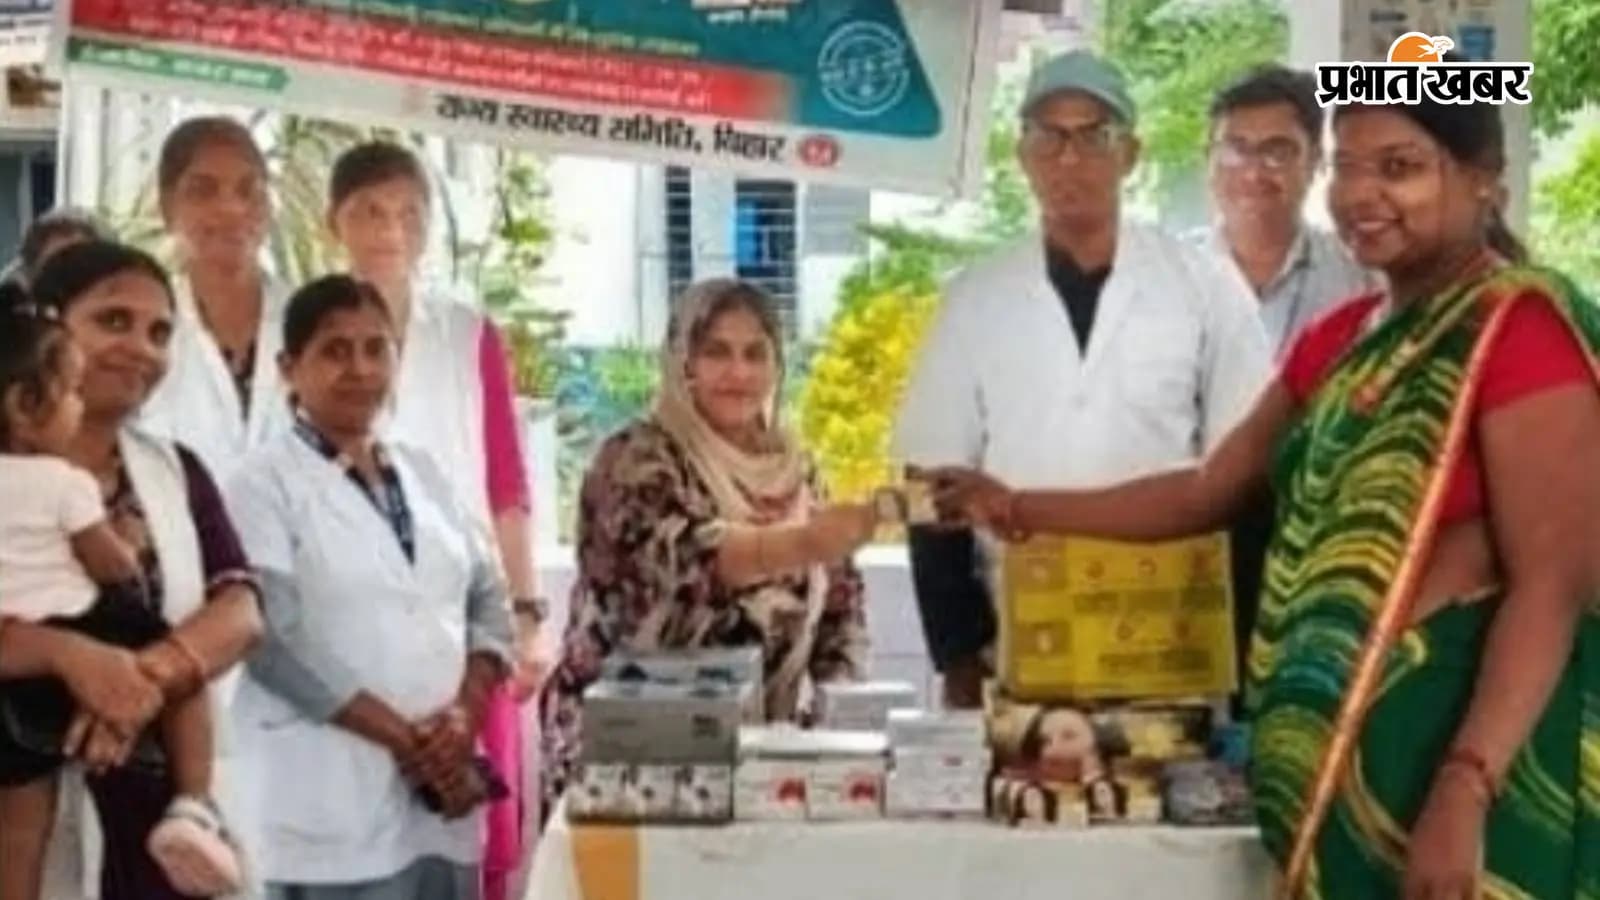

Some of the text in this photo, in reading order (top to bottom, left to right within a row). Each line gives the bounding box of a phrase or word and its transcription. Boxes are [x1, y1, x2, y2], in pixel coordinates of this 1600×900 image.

[436, 93, 786, 161] राज्य स्वास्थ्य समिति, बिहार
